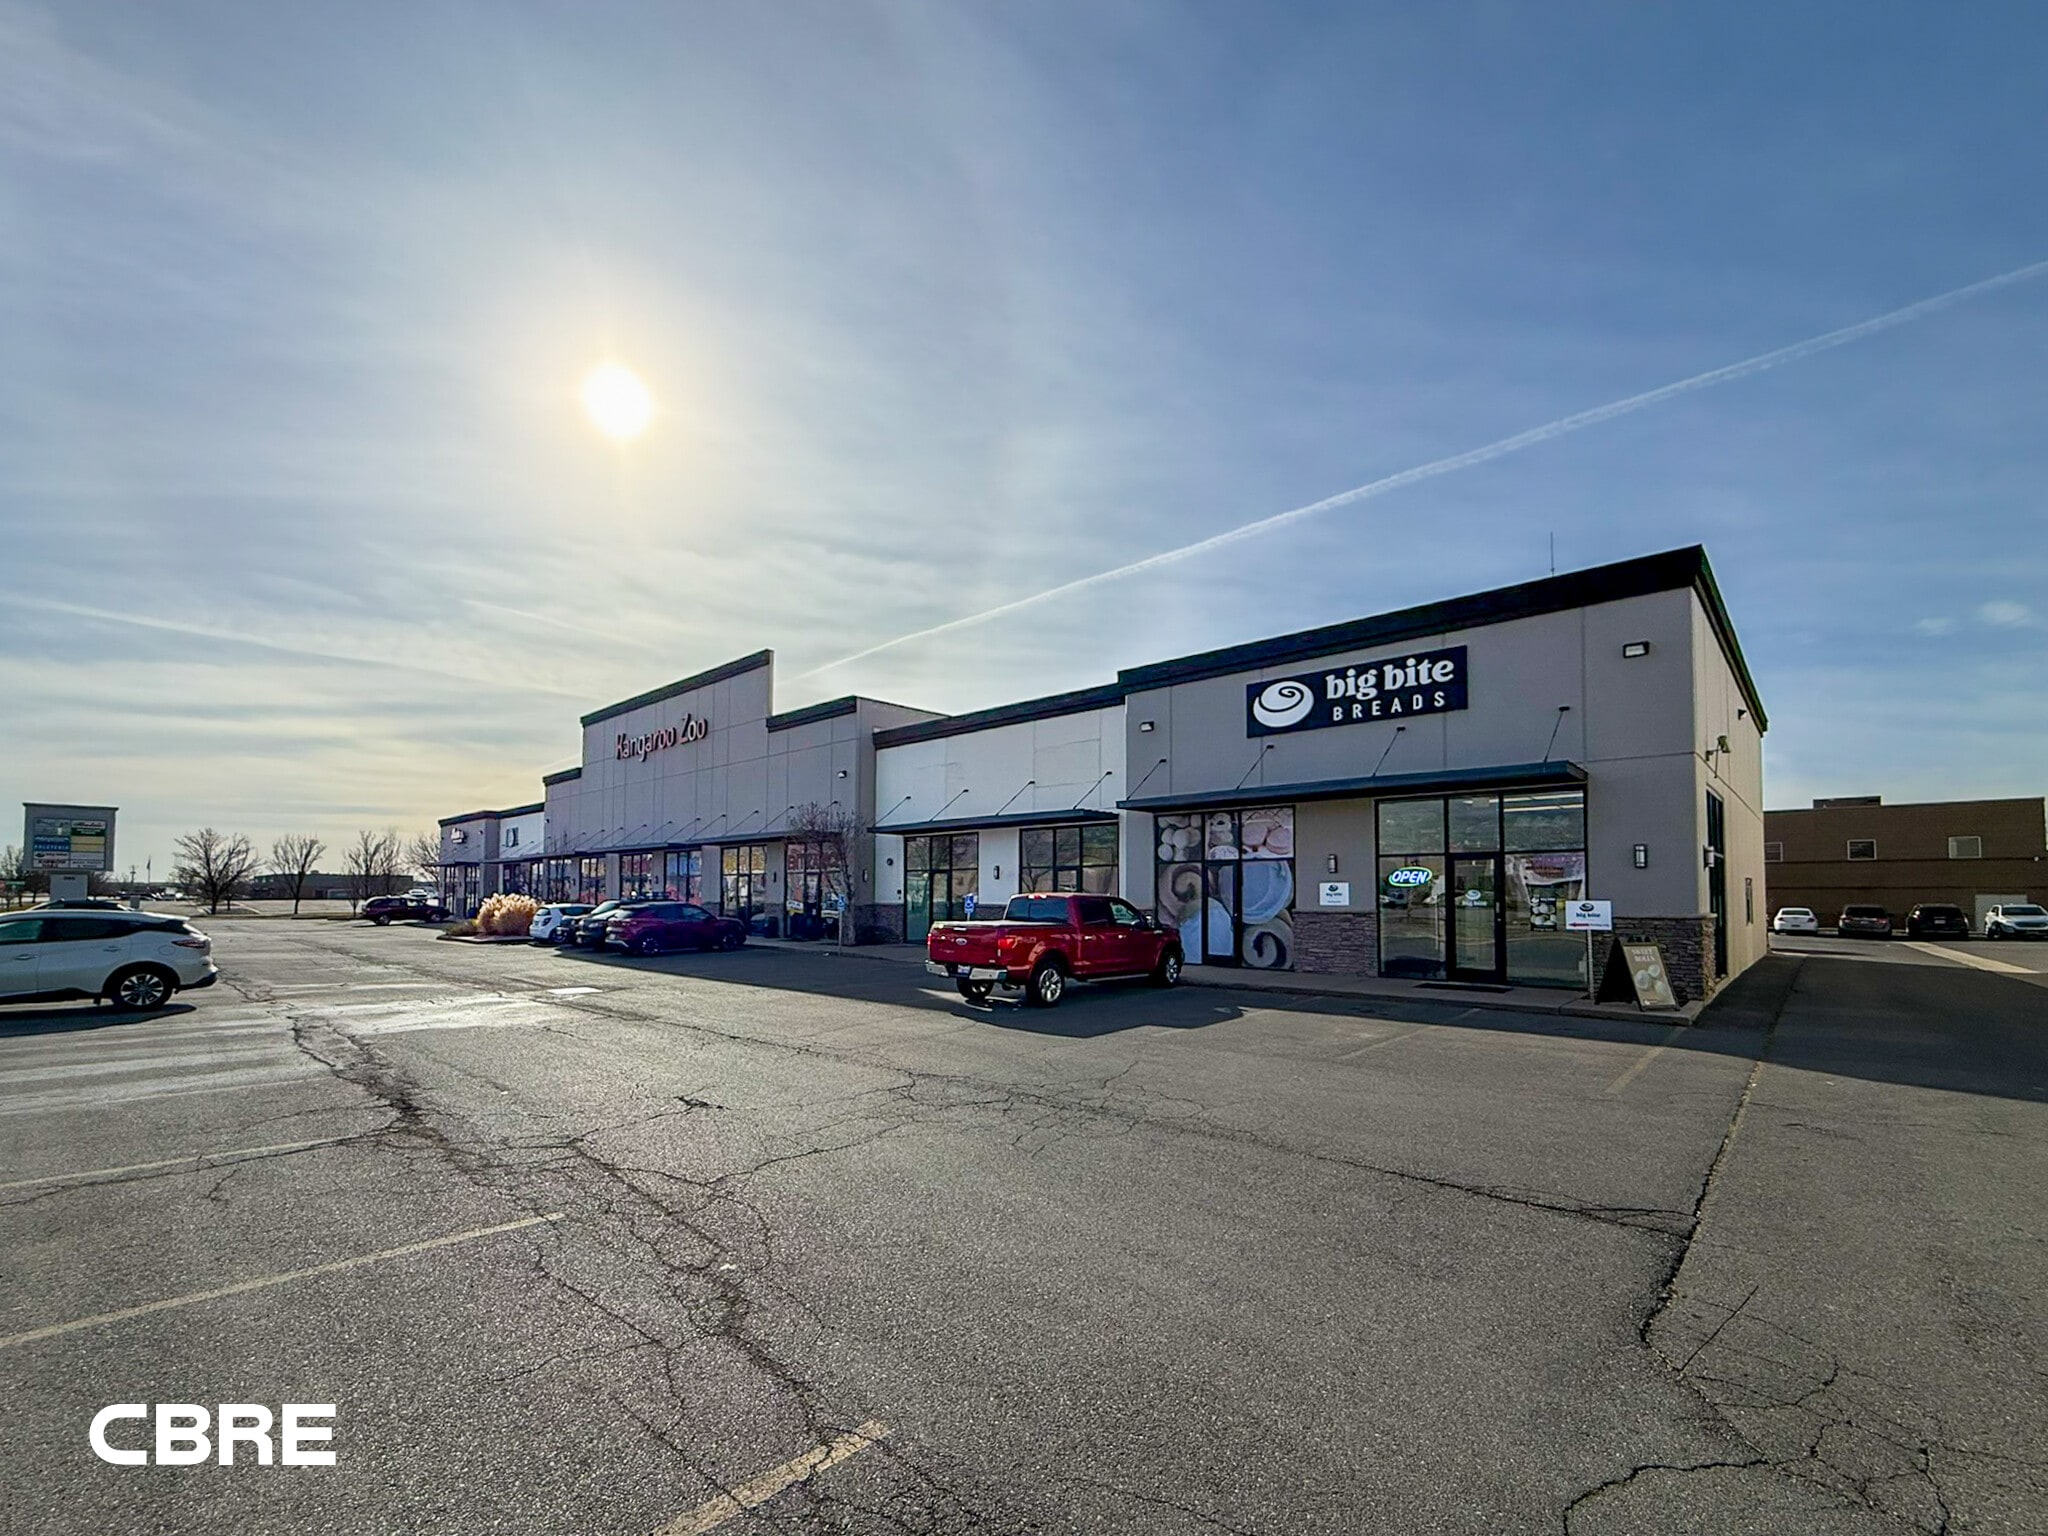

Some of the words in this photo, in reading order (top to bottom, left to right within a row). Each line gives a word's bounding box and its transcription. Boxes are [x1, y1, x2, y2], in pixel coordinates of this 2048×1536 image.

[1325, 668, 1378, 700] big
[1383, 657, 1455, 691] bite
[1333, 691, 1445, 721] BREADS
[616, 726, 677, 763] Kangaroo
[679, 712, 709, 745] Zoo
[1391, 870, 1428, 885] OPEN
